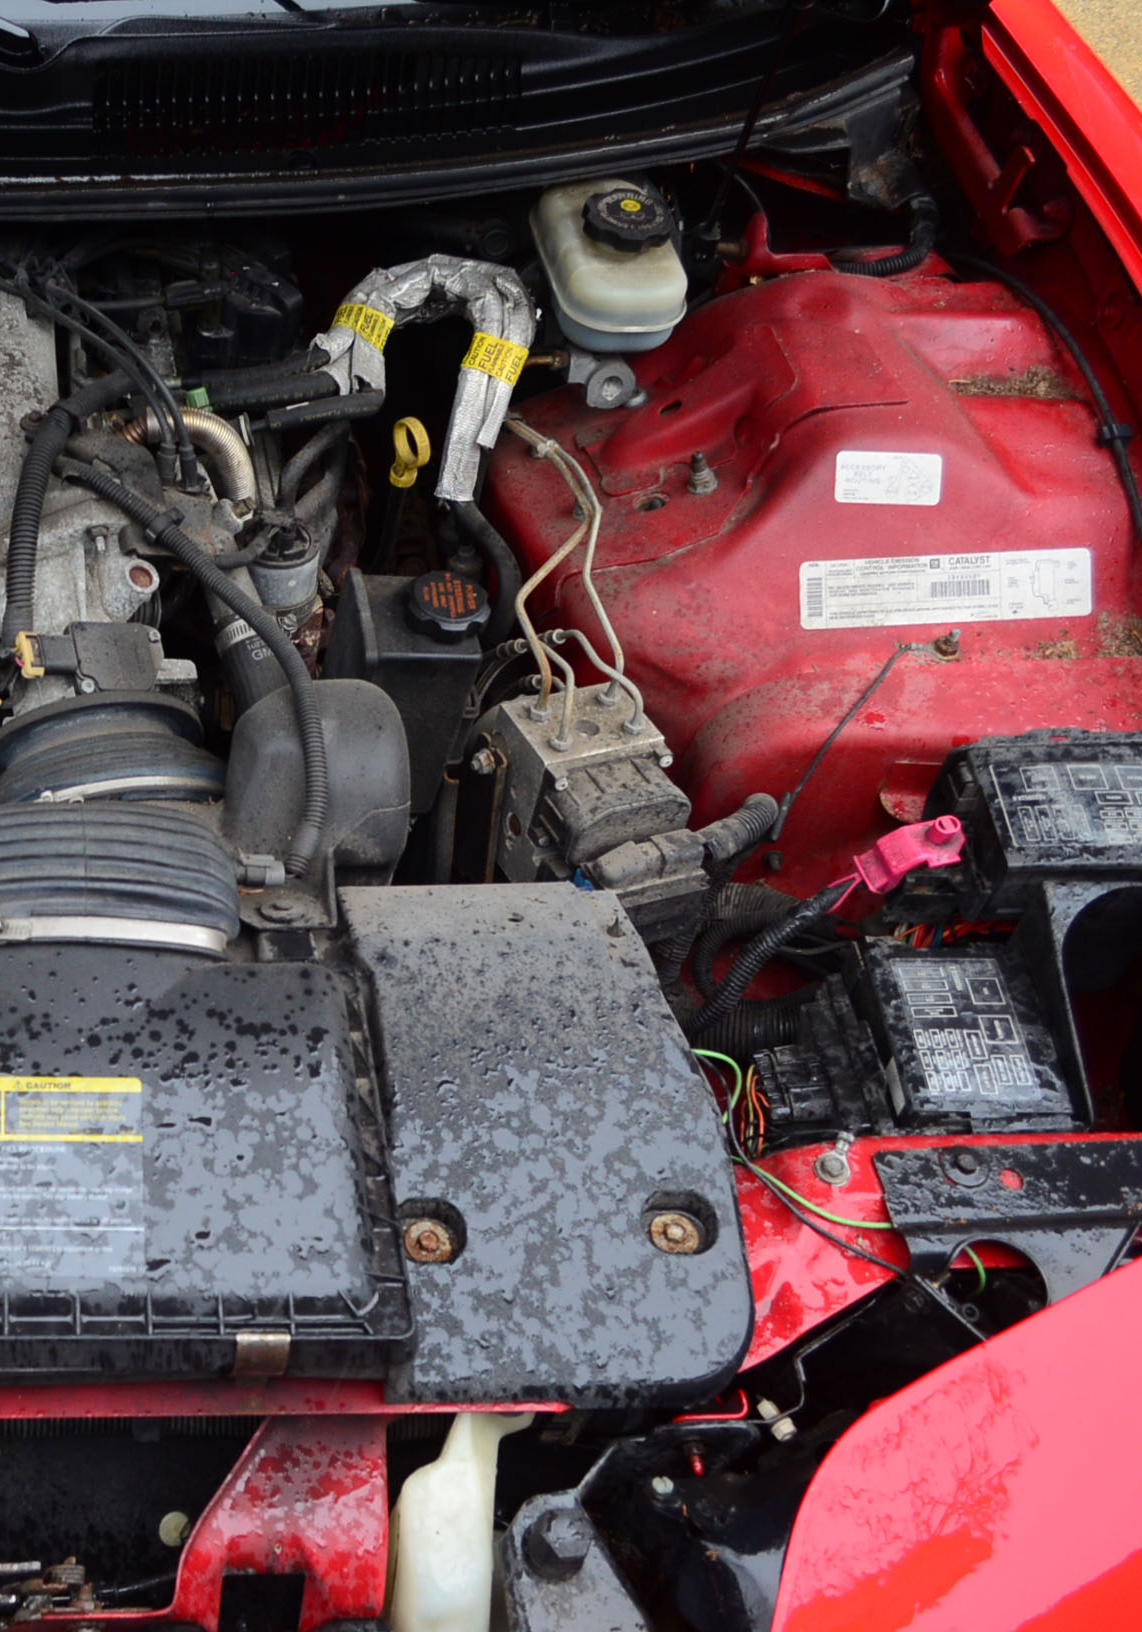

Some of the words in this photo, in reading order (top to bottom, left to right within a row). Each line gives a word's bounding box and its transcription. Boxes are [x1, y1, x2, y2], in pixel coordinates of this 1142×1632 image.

[361, 311, 373, 332] FUEL
[468, 336, 485, 365] CAUTION
[478, 342, 498, 369] FUEL
[495, 348, 513, 377] CAUTION
[506, 352, 524, 381] FUEL
[948, 556, 990, 565] CATALYST
[465, 584, 477, 609] POWER
